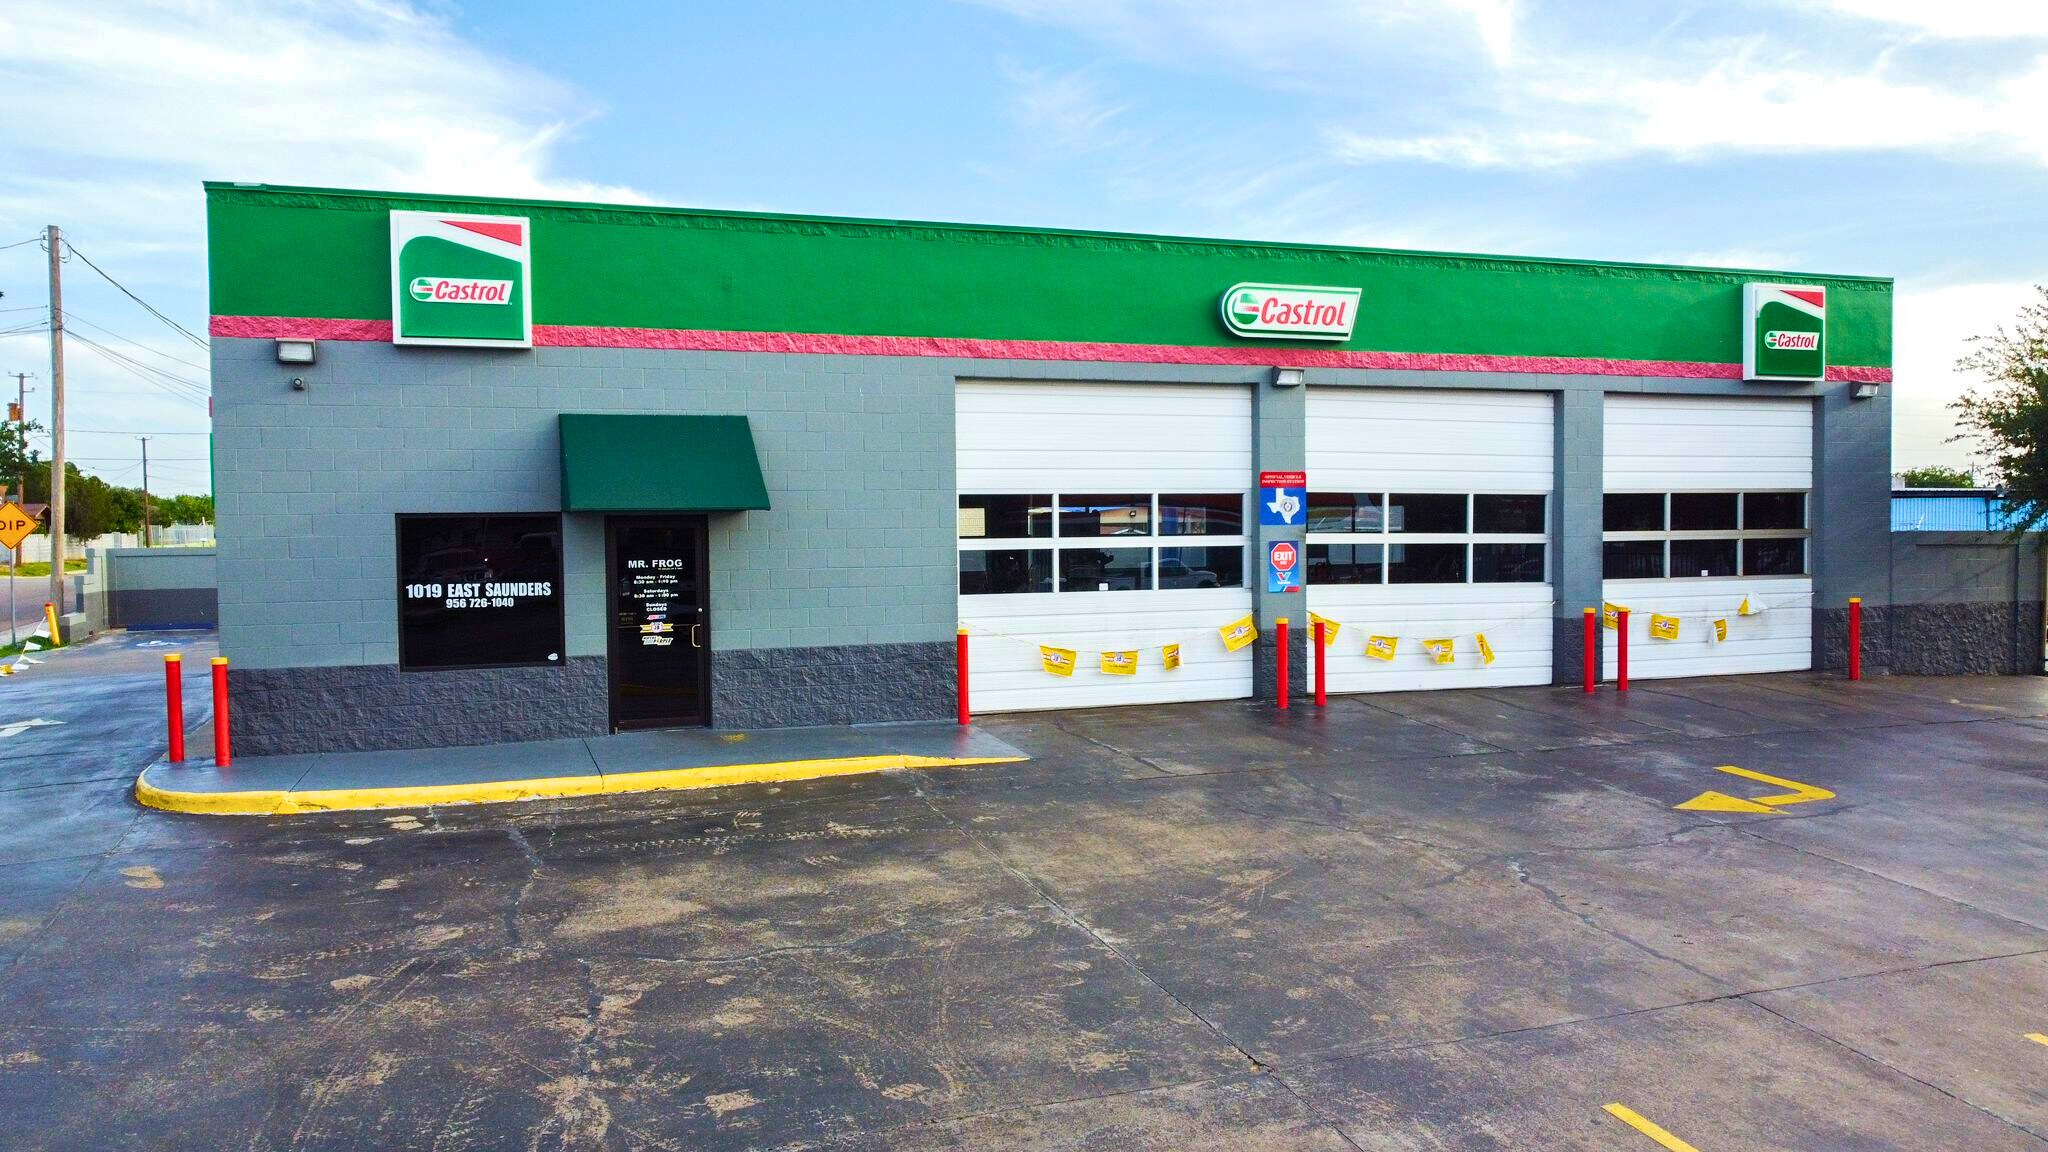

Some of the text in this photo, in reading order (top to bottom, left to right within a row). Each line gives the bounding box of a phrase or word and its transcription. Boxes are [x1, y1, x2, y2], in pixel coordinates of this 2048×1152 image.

[435, 280, 505, 301] Castrol
[1261, 297, 1346, 326] Castrol
[1778, 333, 1815, 348] Castrol
[0, 520, 26, 531] DIP
[1274, 551, 1293, 561] EXIT
[628, 559, 682, 569] MR. FROG
[406, 582, 552, 598] 1019 EAST SAUNDERS
[446, 598, 514, 609] 956 726-1040
